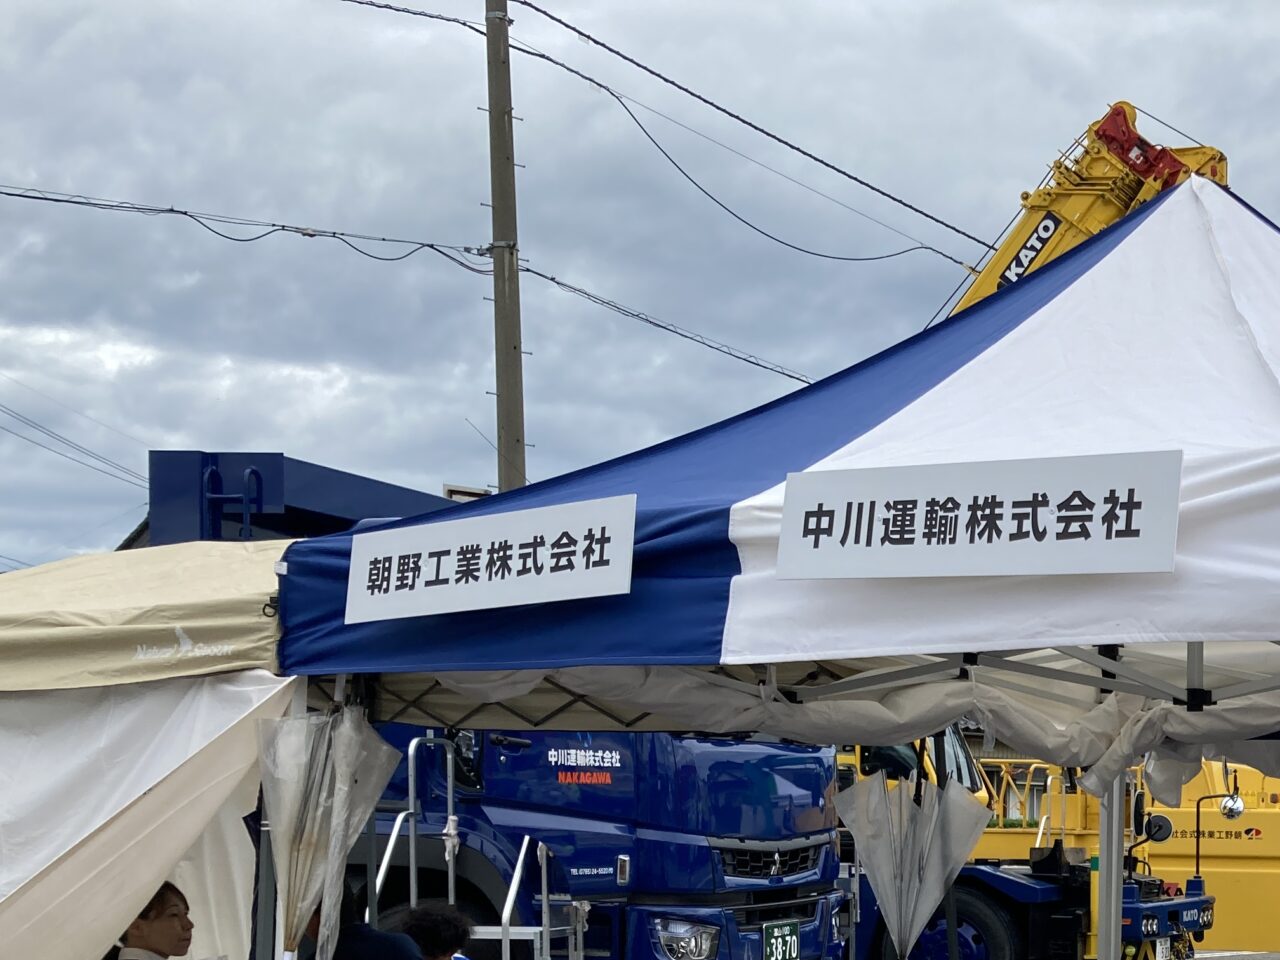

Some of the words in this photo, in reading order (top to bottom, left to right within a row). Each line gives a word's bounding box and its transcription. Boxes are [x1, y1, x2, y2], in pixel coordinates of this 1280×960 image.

[1004, 219, 1056, 282] KATO
[801, 488, 1144, 549] 中川運輸株式会社
[366, 526, 612, 596] 朝野工業株式会社
[548, 748, 621, 767] 中川運輸株式会社
[558, 771, 612, 784] NAKAGAWA
[1183, 909, 1199, 922] KATO
